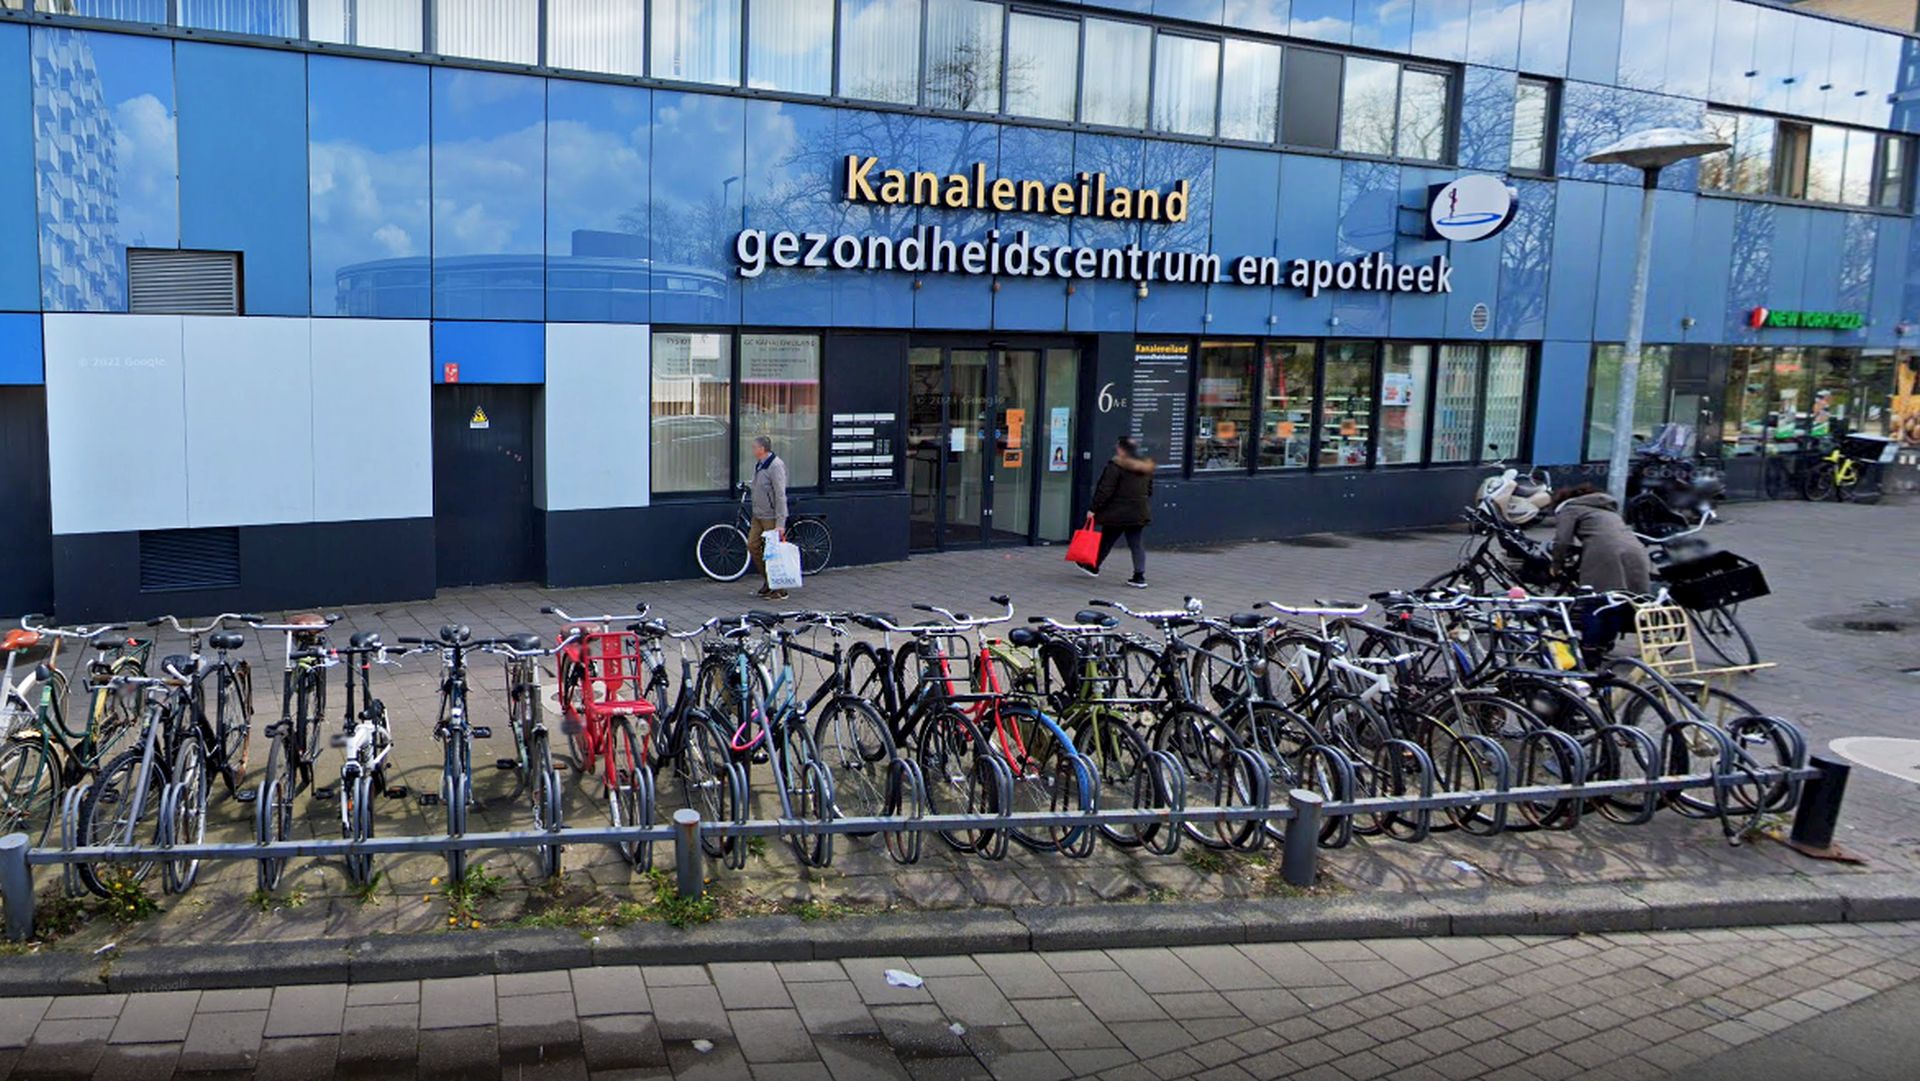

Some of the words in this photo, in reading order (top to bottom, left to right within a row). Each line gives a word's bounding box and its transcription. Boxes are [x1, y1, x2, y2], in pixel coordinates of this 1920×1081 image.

[847, 155, 1189, 223] Kanaleneiland
[736, 224, 1221, 284] gezondheidscentrum
[1239, 255, 1280, 285] en
[1290, 252, 1453, 297] apotheek
